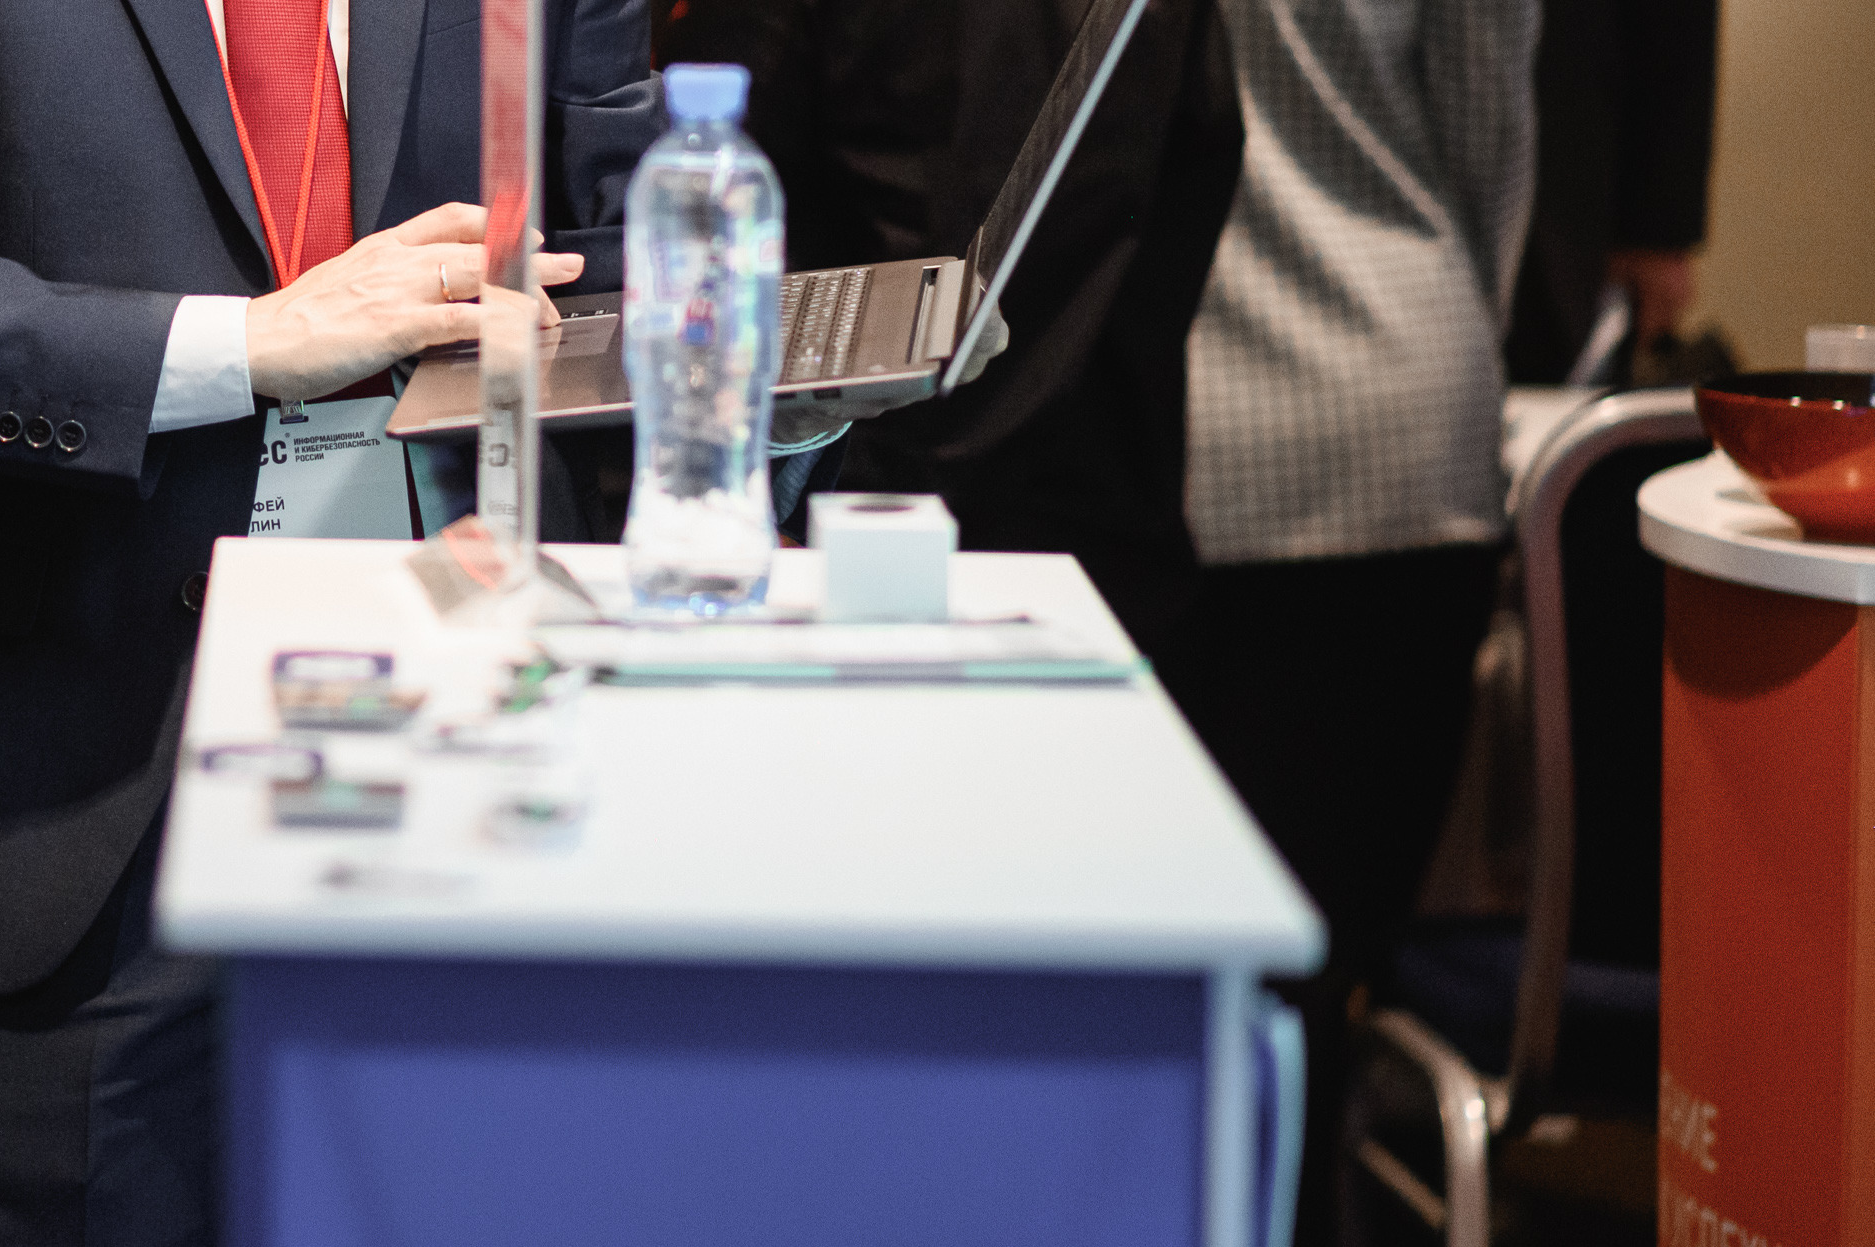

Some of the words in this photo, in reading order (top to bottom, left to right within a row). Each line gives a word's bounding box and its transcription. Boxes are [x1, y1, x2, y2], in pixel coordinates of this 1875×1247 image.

[293, 431, 365, 446] ИНФОРМАЦИОННАЯ
[301, 438, 381, 453] КИБЕРБЕЗОПАСНОСТЬ
[295, 453, 325, 463] РОССИИ
[253, 496, 285, 513] ФЕЙ
